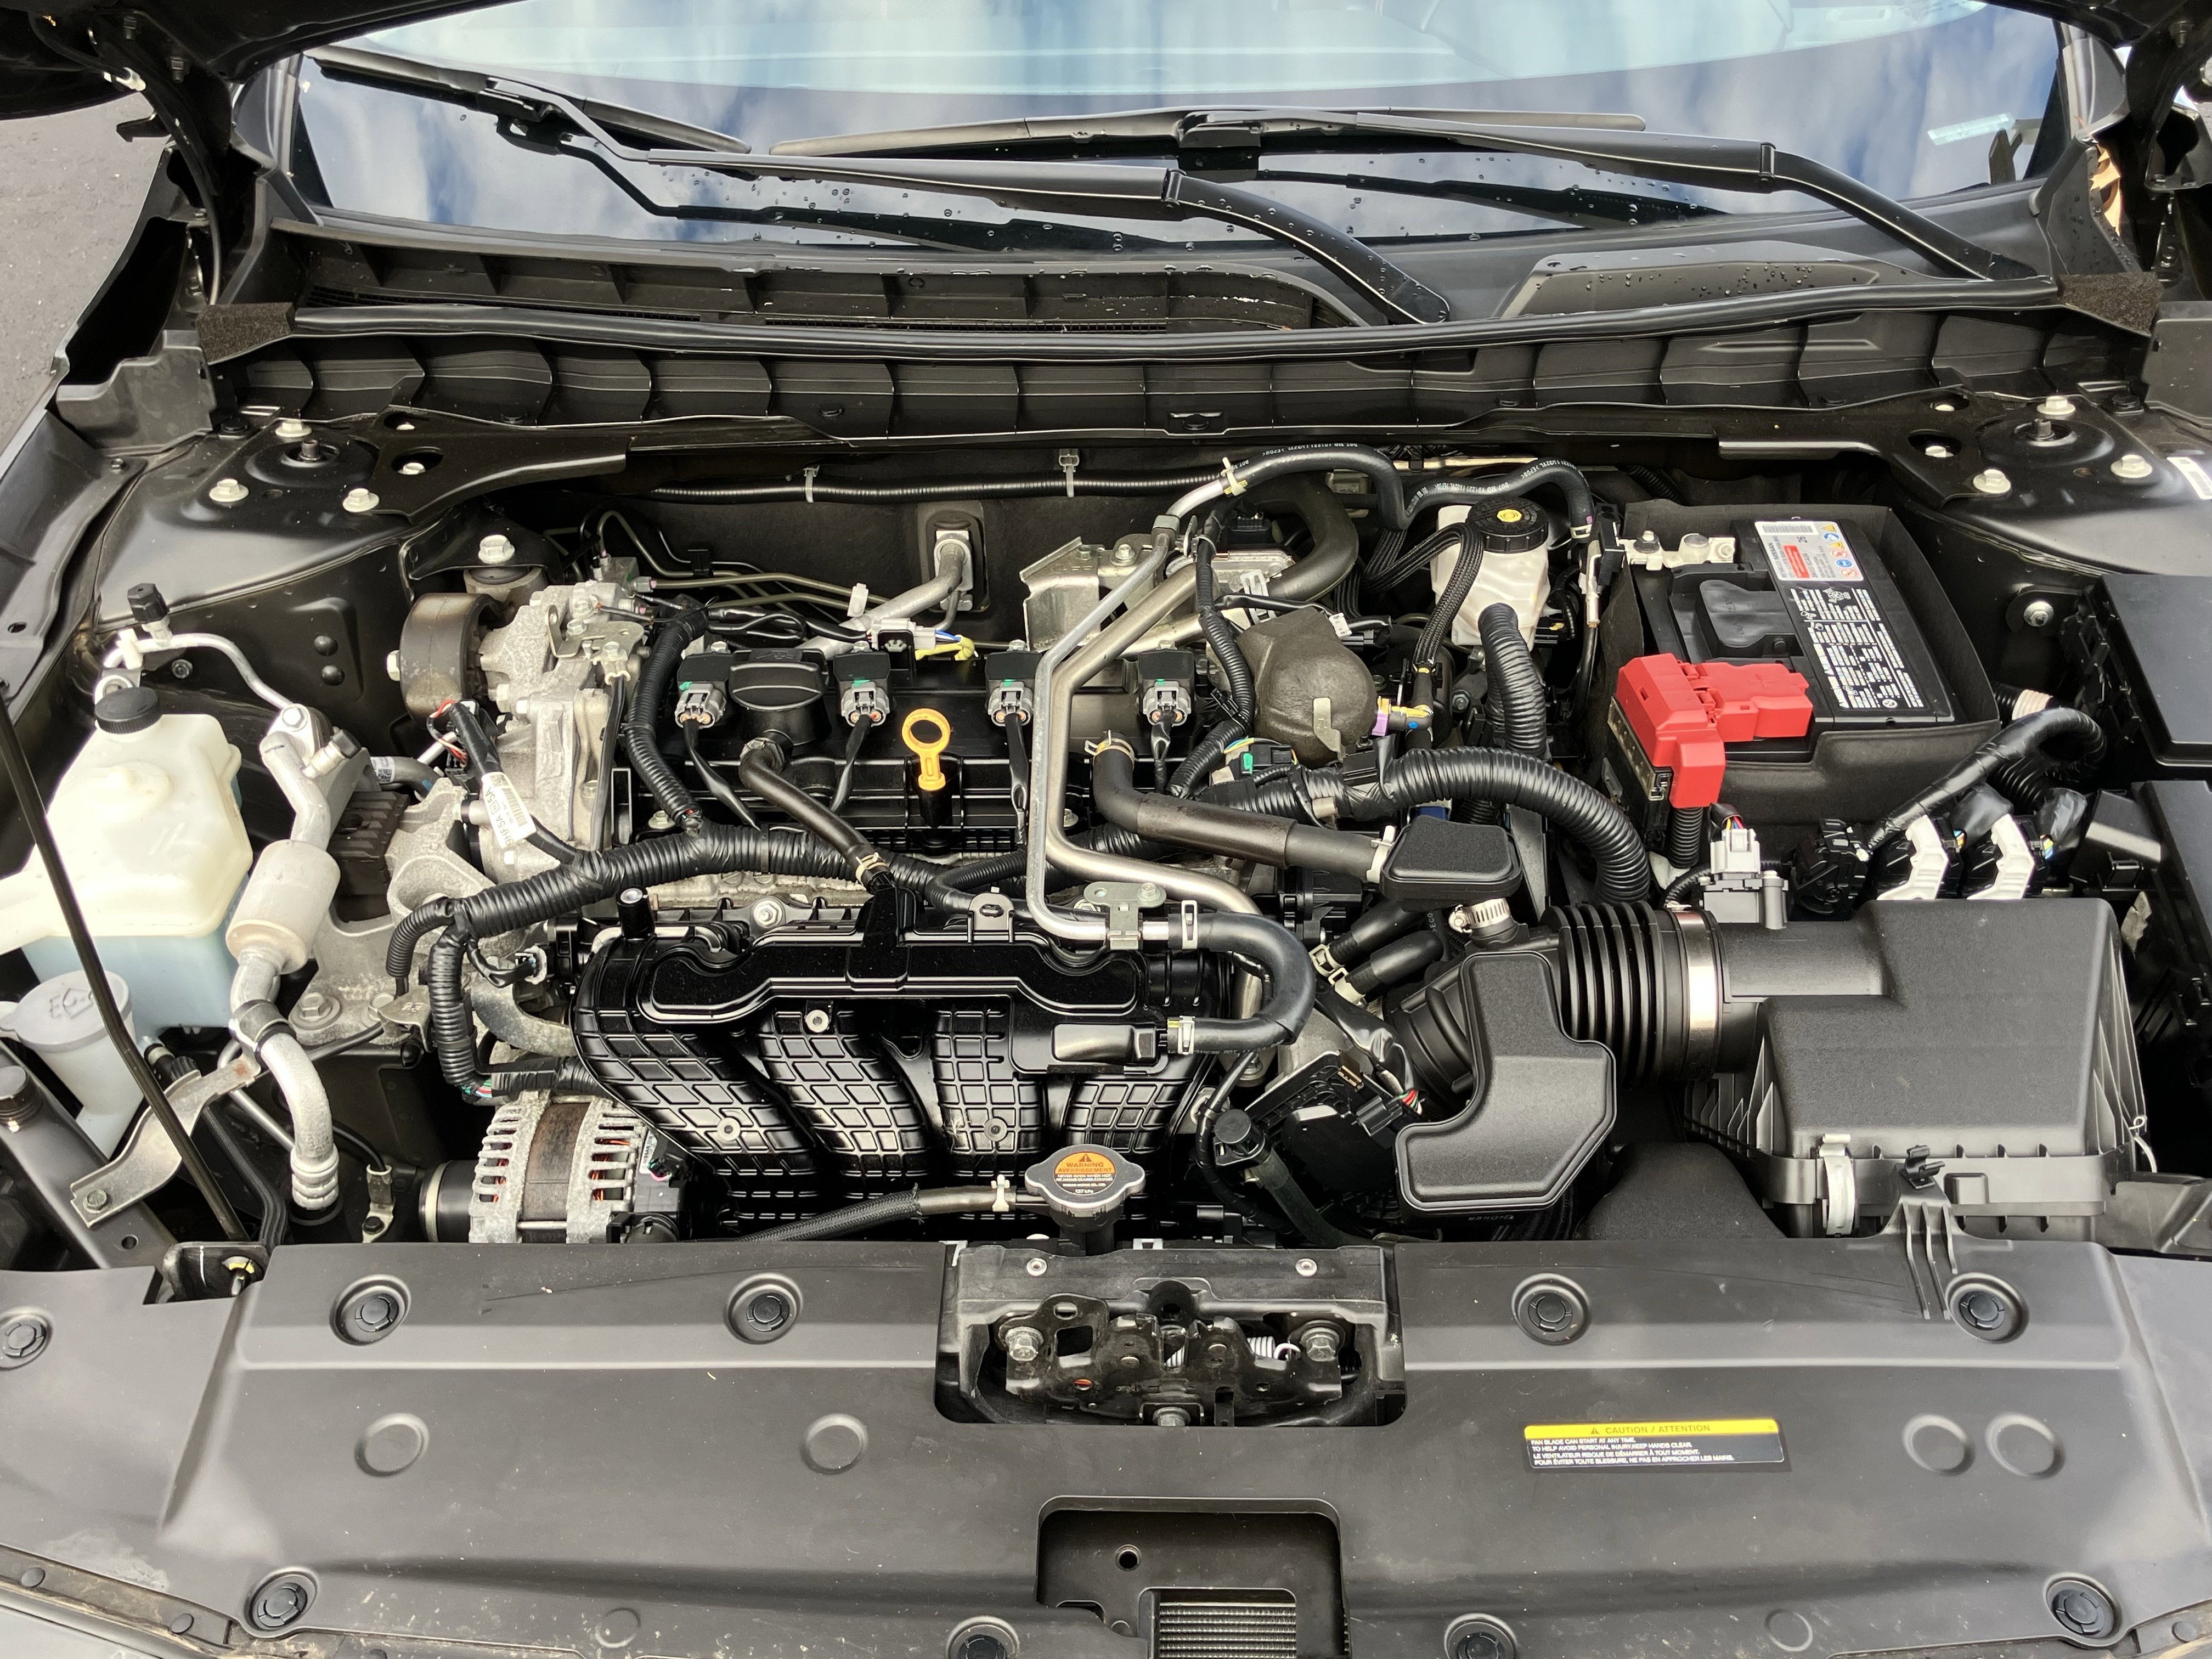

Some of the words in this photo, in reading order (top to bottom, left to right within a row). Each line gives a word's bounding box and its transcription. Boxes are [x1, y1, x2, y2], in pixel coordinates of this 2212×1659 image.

[1498, 482, 1510, 491] DOT
[485, 786, 496, 803] 5A
[495, 814, 514, 845] 9HF5A
[1605, 1426, 1648, 1435] CAUTION
[1658, 1424, 1711, 1433] ATTENTION
